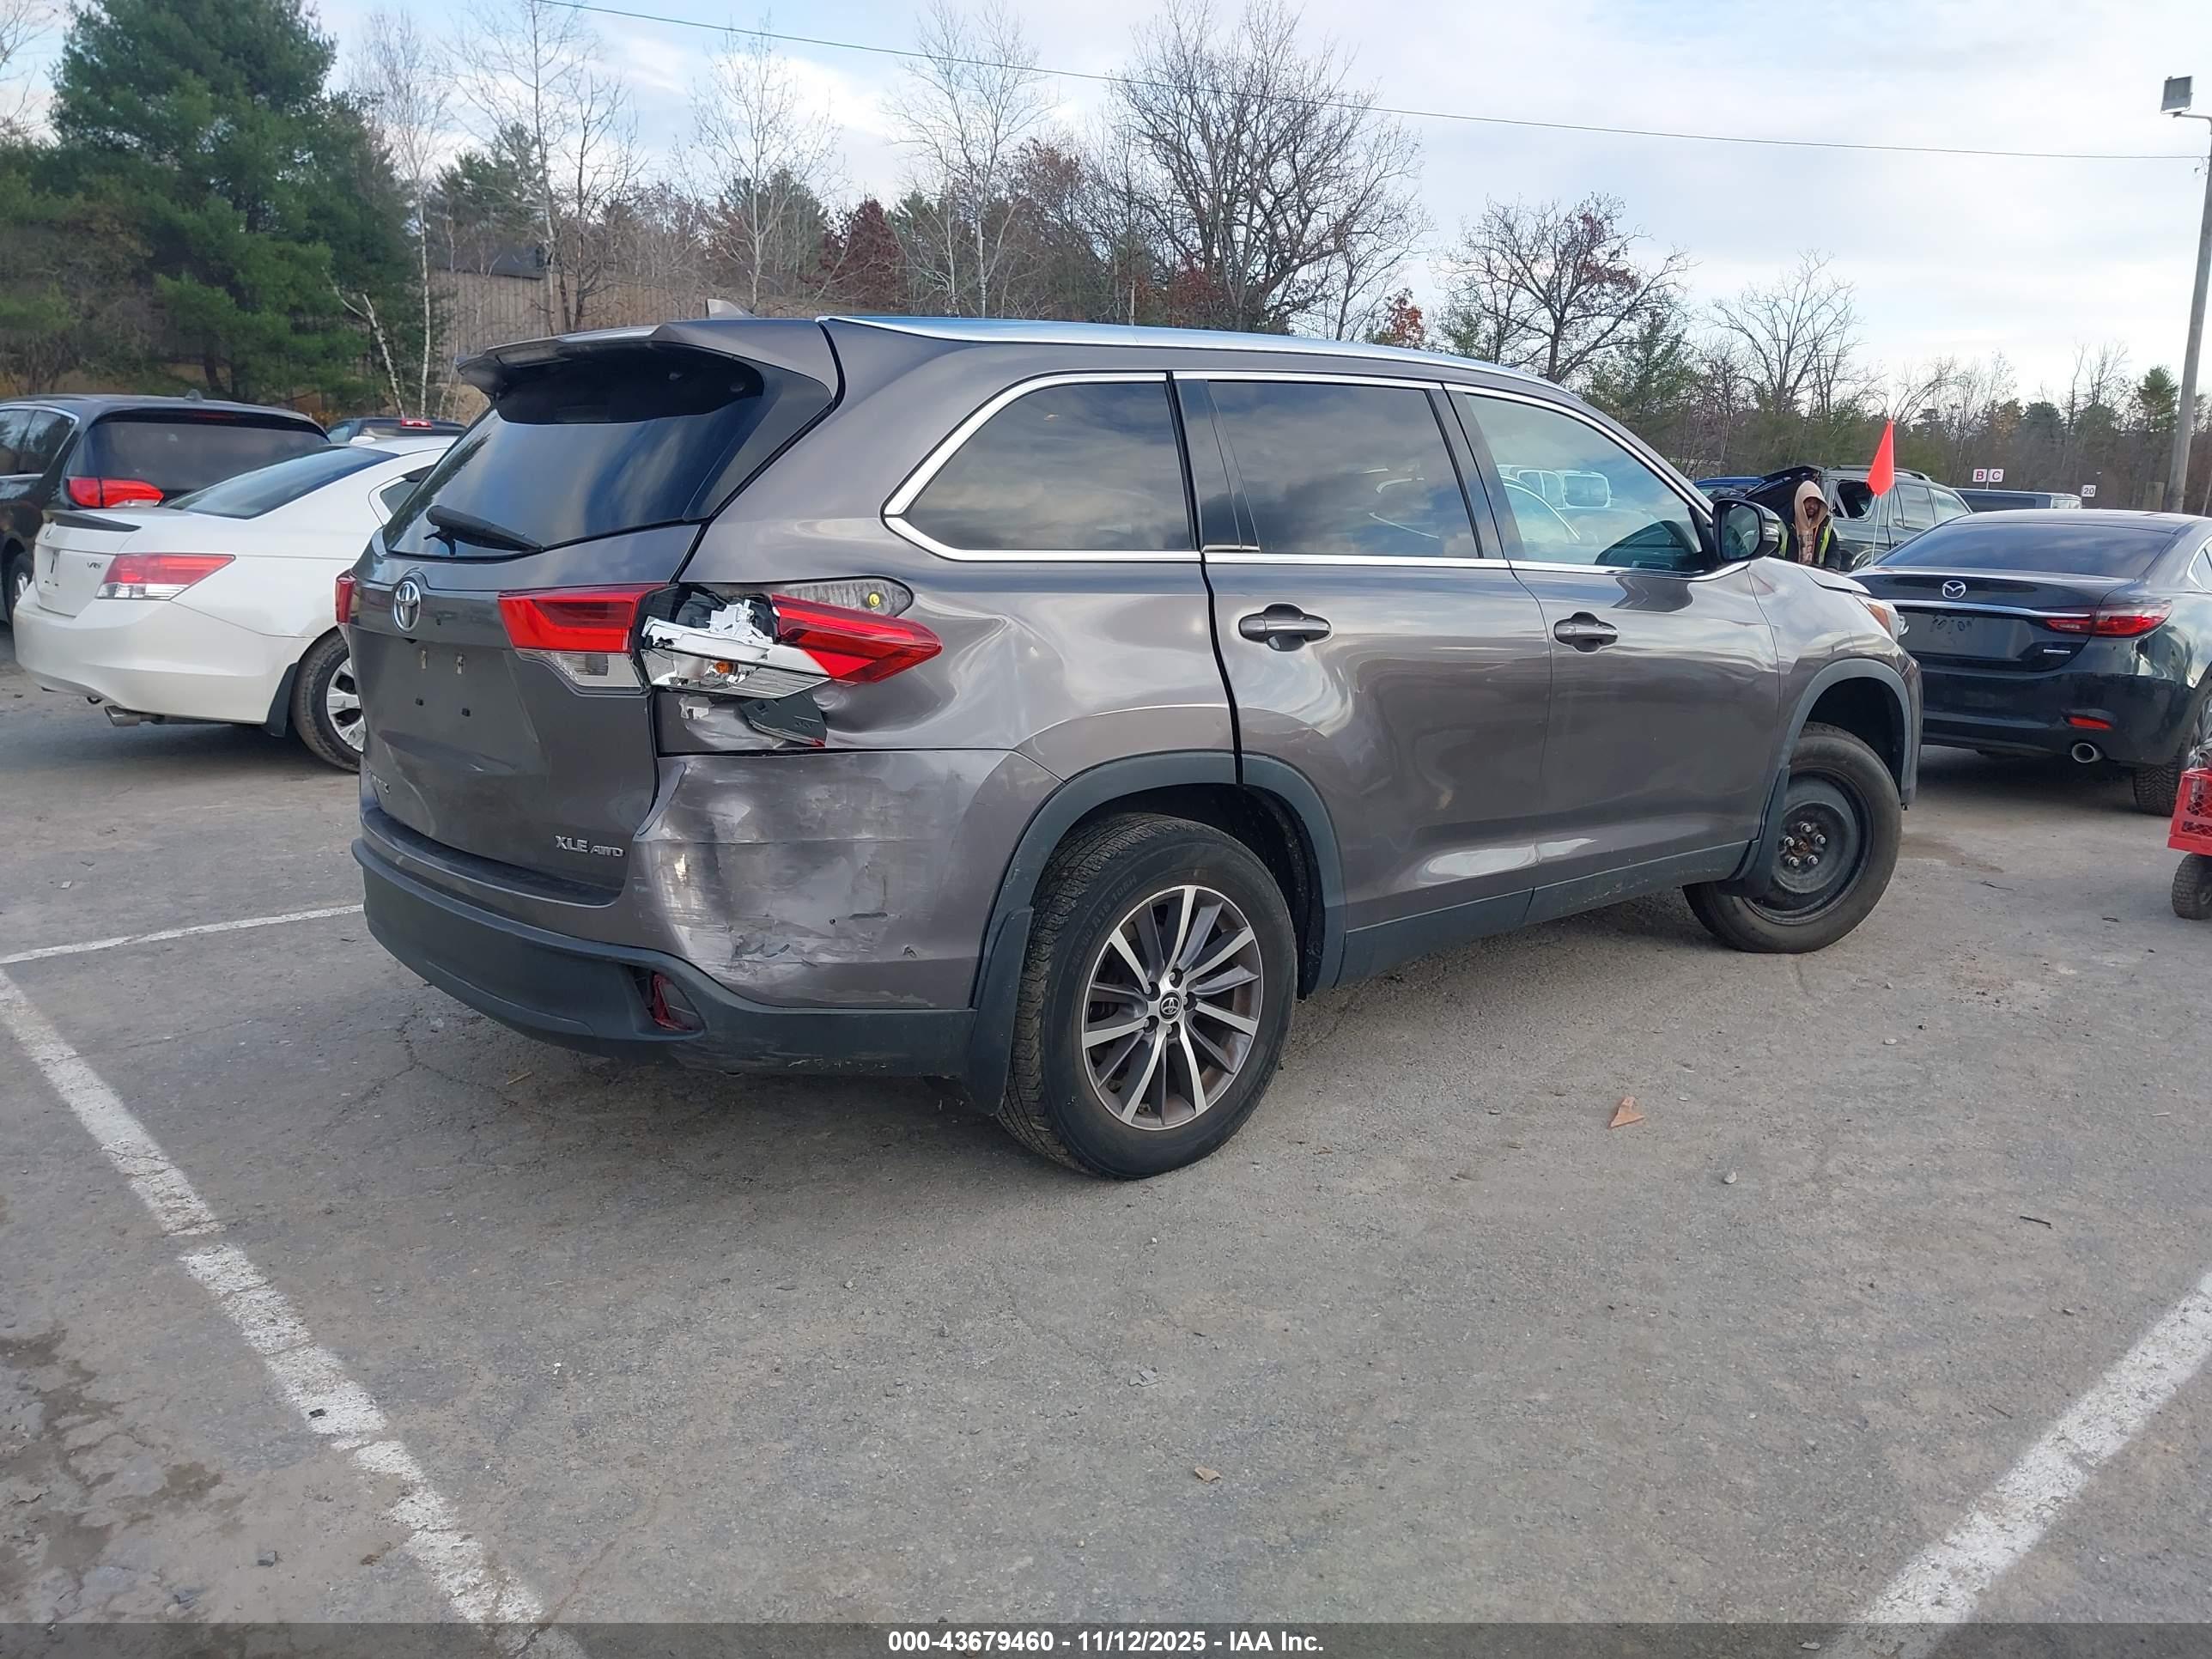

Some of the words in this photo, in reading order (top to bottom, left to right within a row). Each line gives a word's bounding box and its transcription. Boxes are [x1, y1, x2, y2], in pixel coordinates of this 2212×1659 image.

[1976, 471, 1984, 481] B
[1991, 471, 2002, 481] C
[2083, 487, 2094, 495] 20
[555, 835, 588, 853] XLE
